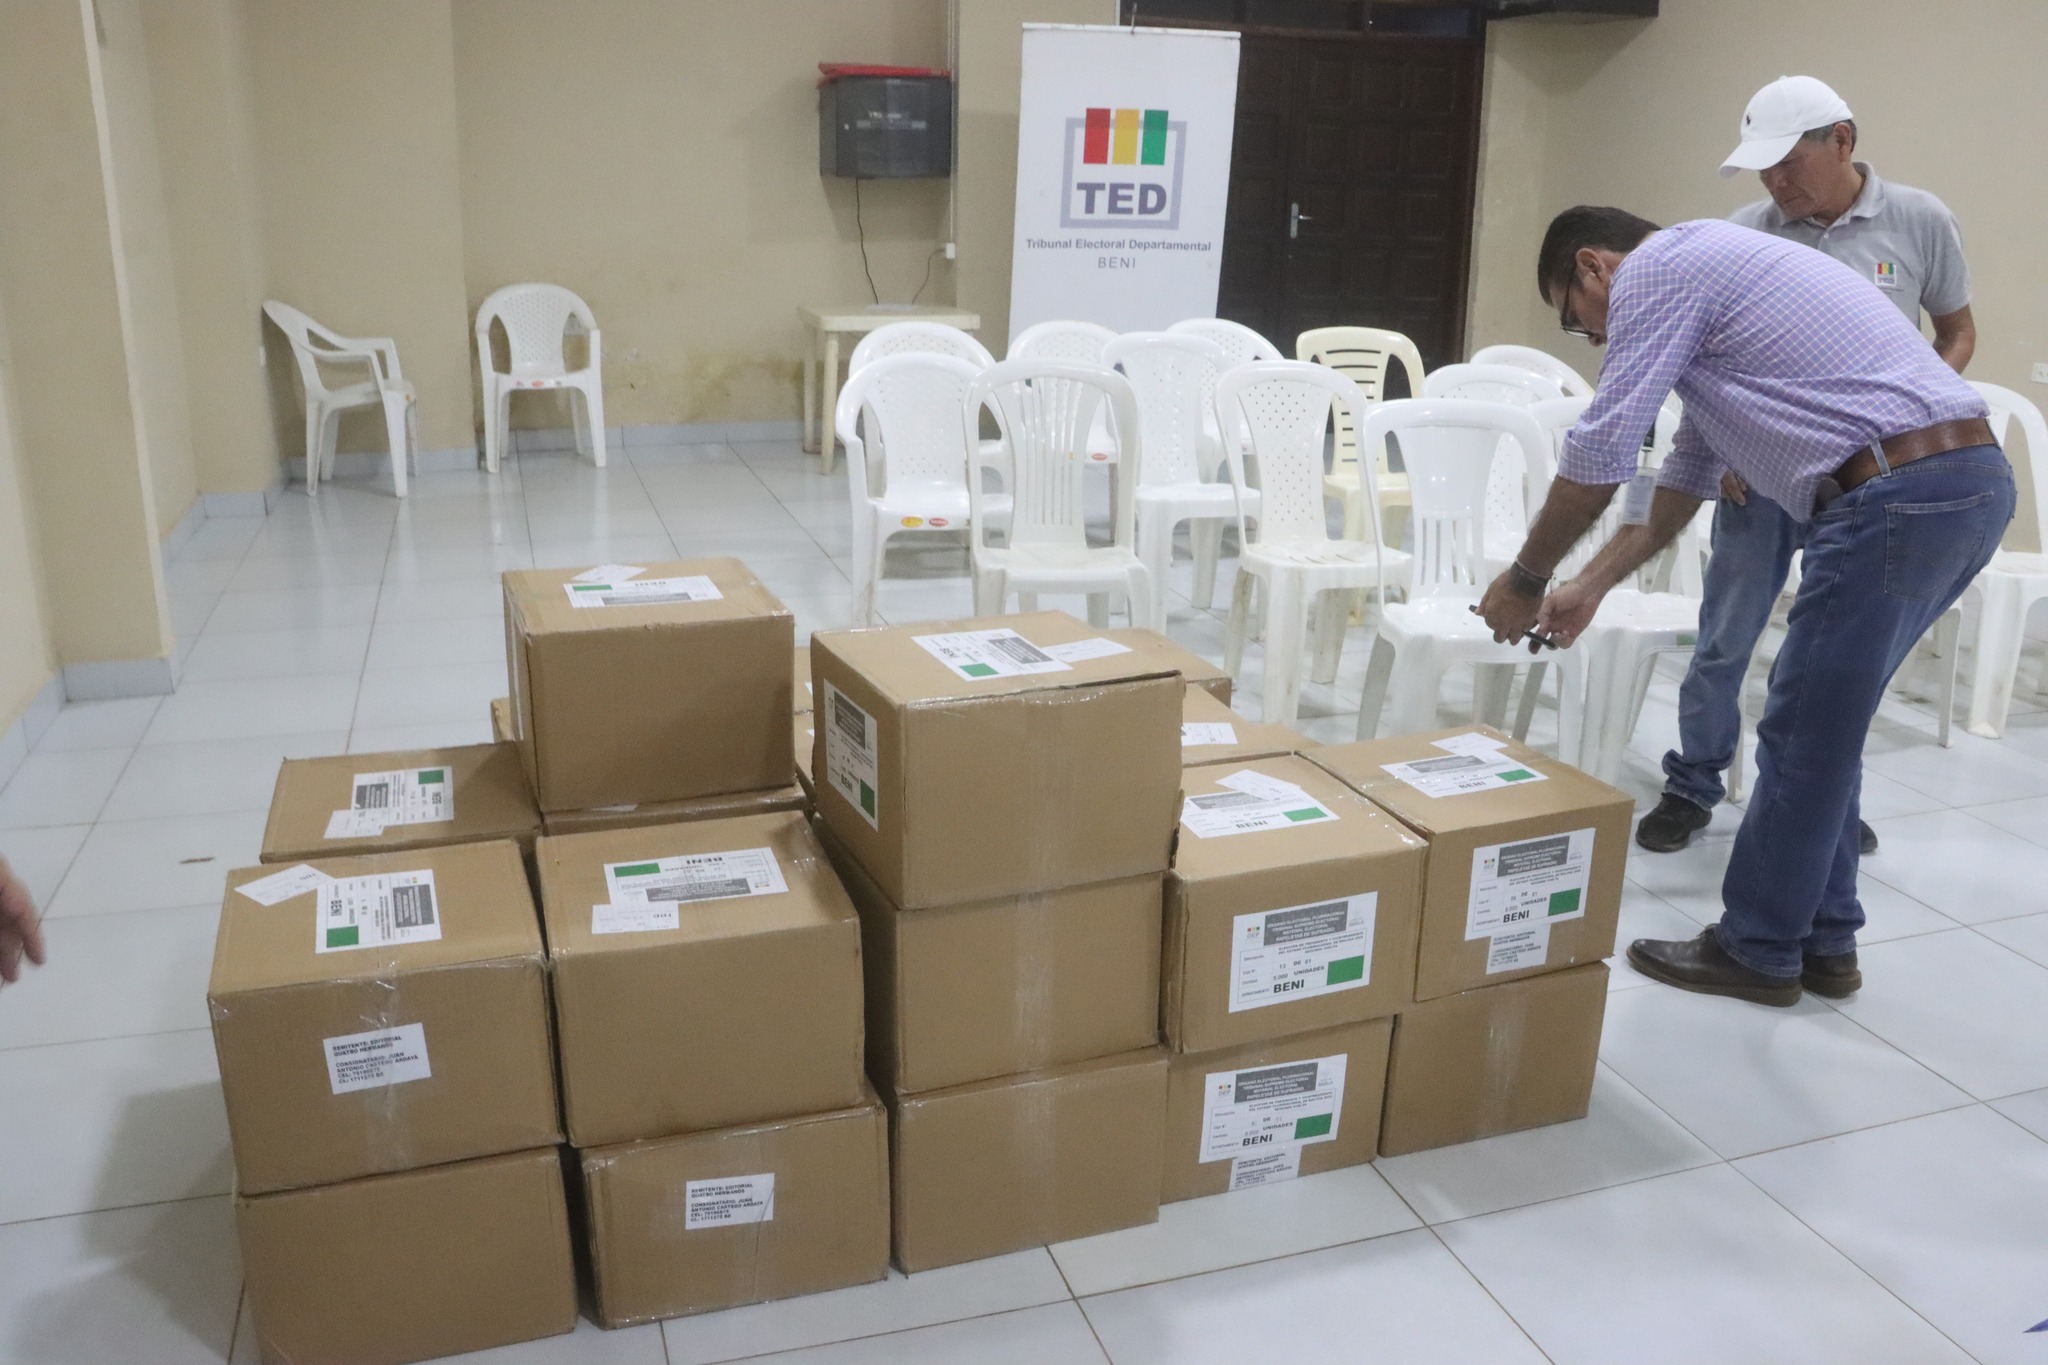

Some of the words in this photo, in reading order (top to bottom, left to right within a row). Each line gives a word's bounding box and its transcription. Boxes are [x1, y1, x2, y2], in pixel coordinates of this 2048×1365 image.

[1077, 182, 1167, 215] TED
[1026, 238, 1072, 249] Tribunal
[1076, 239, 1125, 249] Electoral
[1129, 239, 1211, 251] Departamental
[1098, 257, 1136, 269] BENI
[1235, 820, 1269, 829] BENI
[1503, 910, 1529, 923] BENI
[1294, 966, 1324, 976] UNIDADES
[1274, 979, 1304, 994] BENI
[1263, 1122, 1293, 1131] UNIDADES
[1242, 1134, 1273, 1147] BENI
